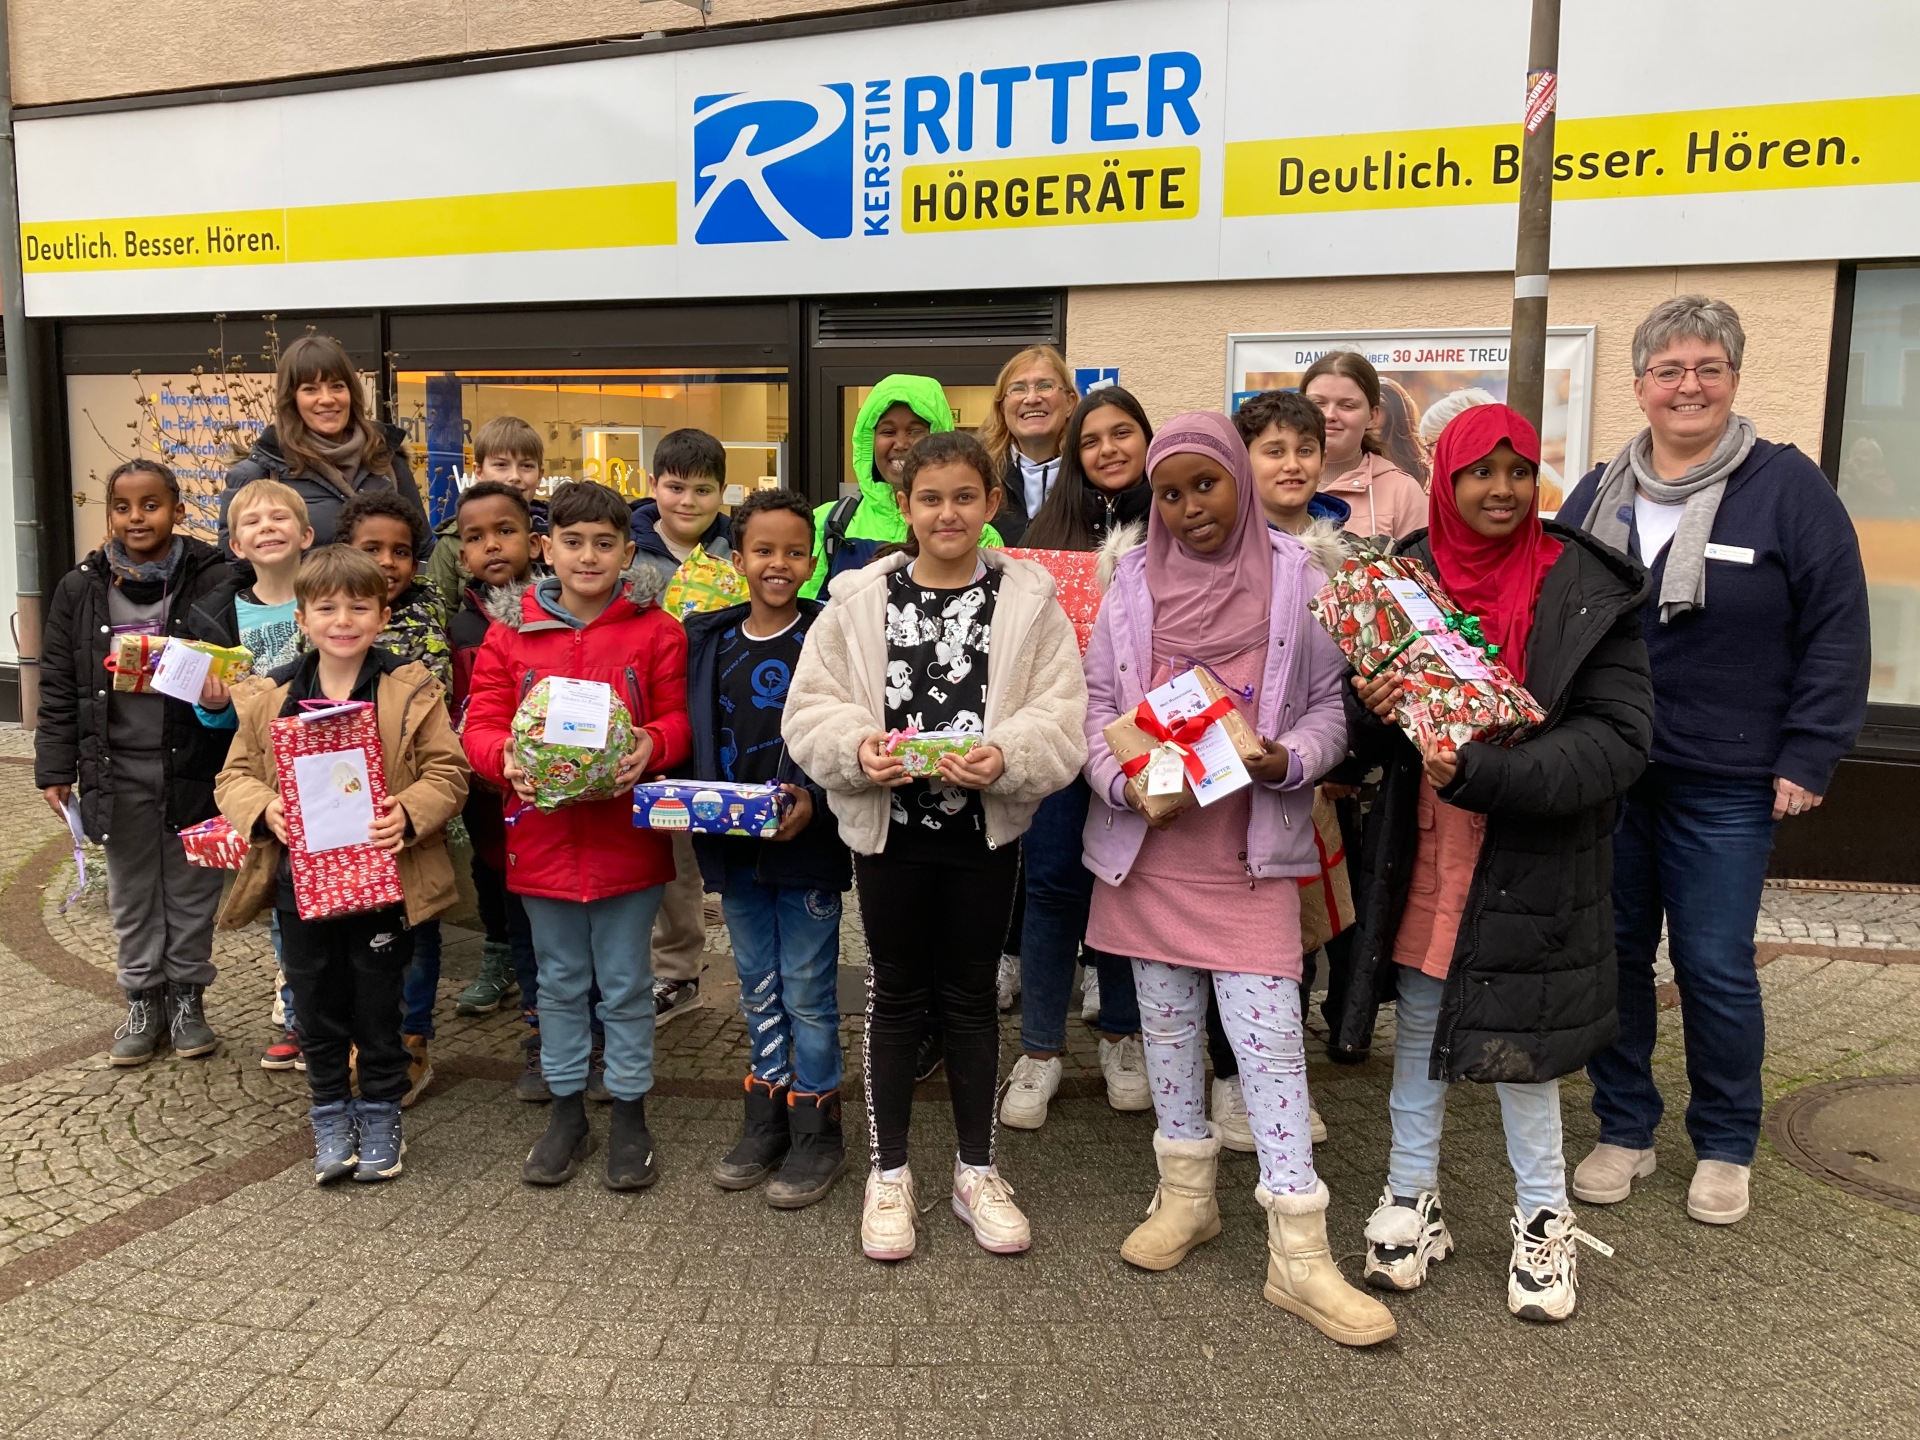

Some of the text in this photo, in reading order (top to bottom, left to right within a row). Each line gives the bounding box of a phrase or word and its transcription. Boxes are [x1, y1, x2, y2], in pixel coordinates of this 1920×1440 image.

[904, 51, 1201, 156] RITTER
[864, 79, 891, 237] KERSTIN
[1279, 130, 1861, 196] Deutlich. Bsser. Hören.
[913, 159, 1185, 223] HÖRGERÄTE
[26, 225, 280, 261] Deutlich. Besser. Hören.
[1392, 349, 1411, 363] 30
[1415, 348, 1465, 363] JAHRE
